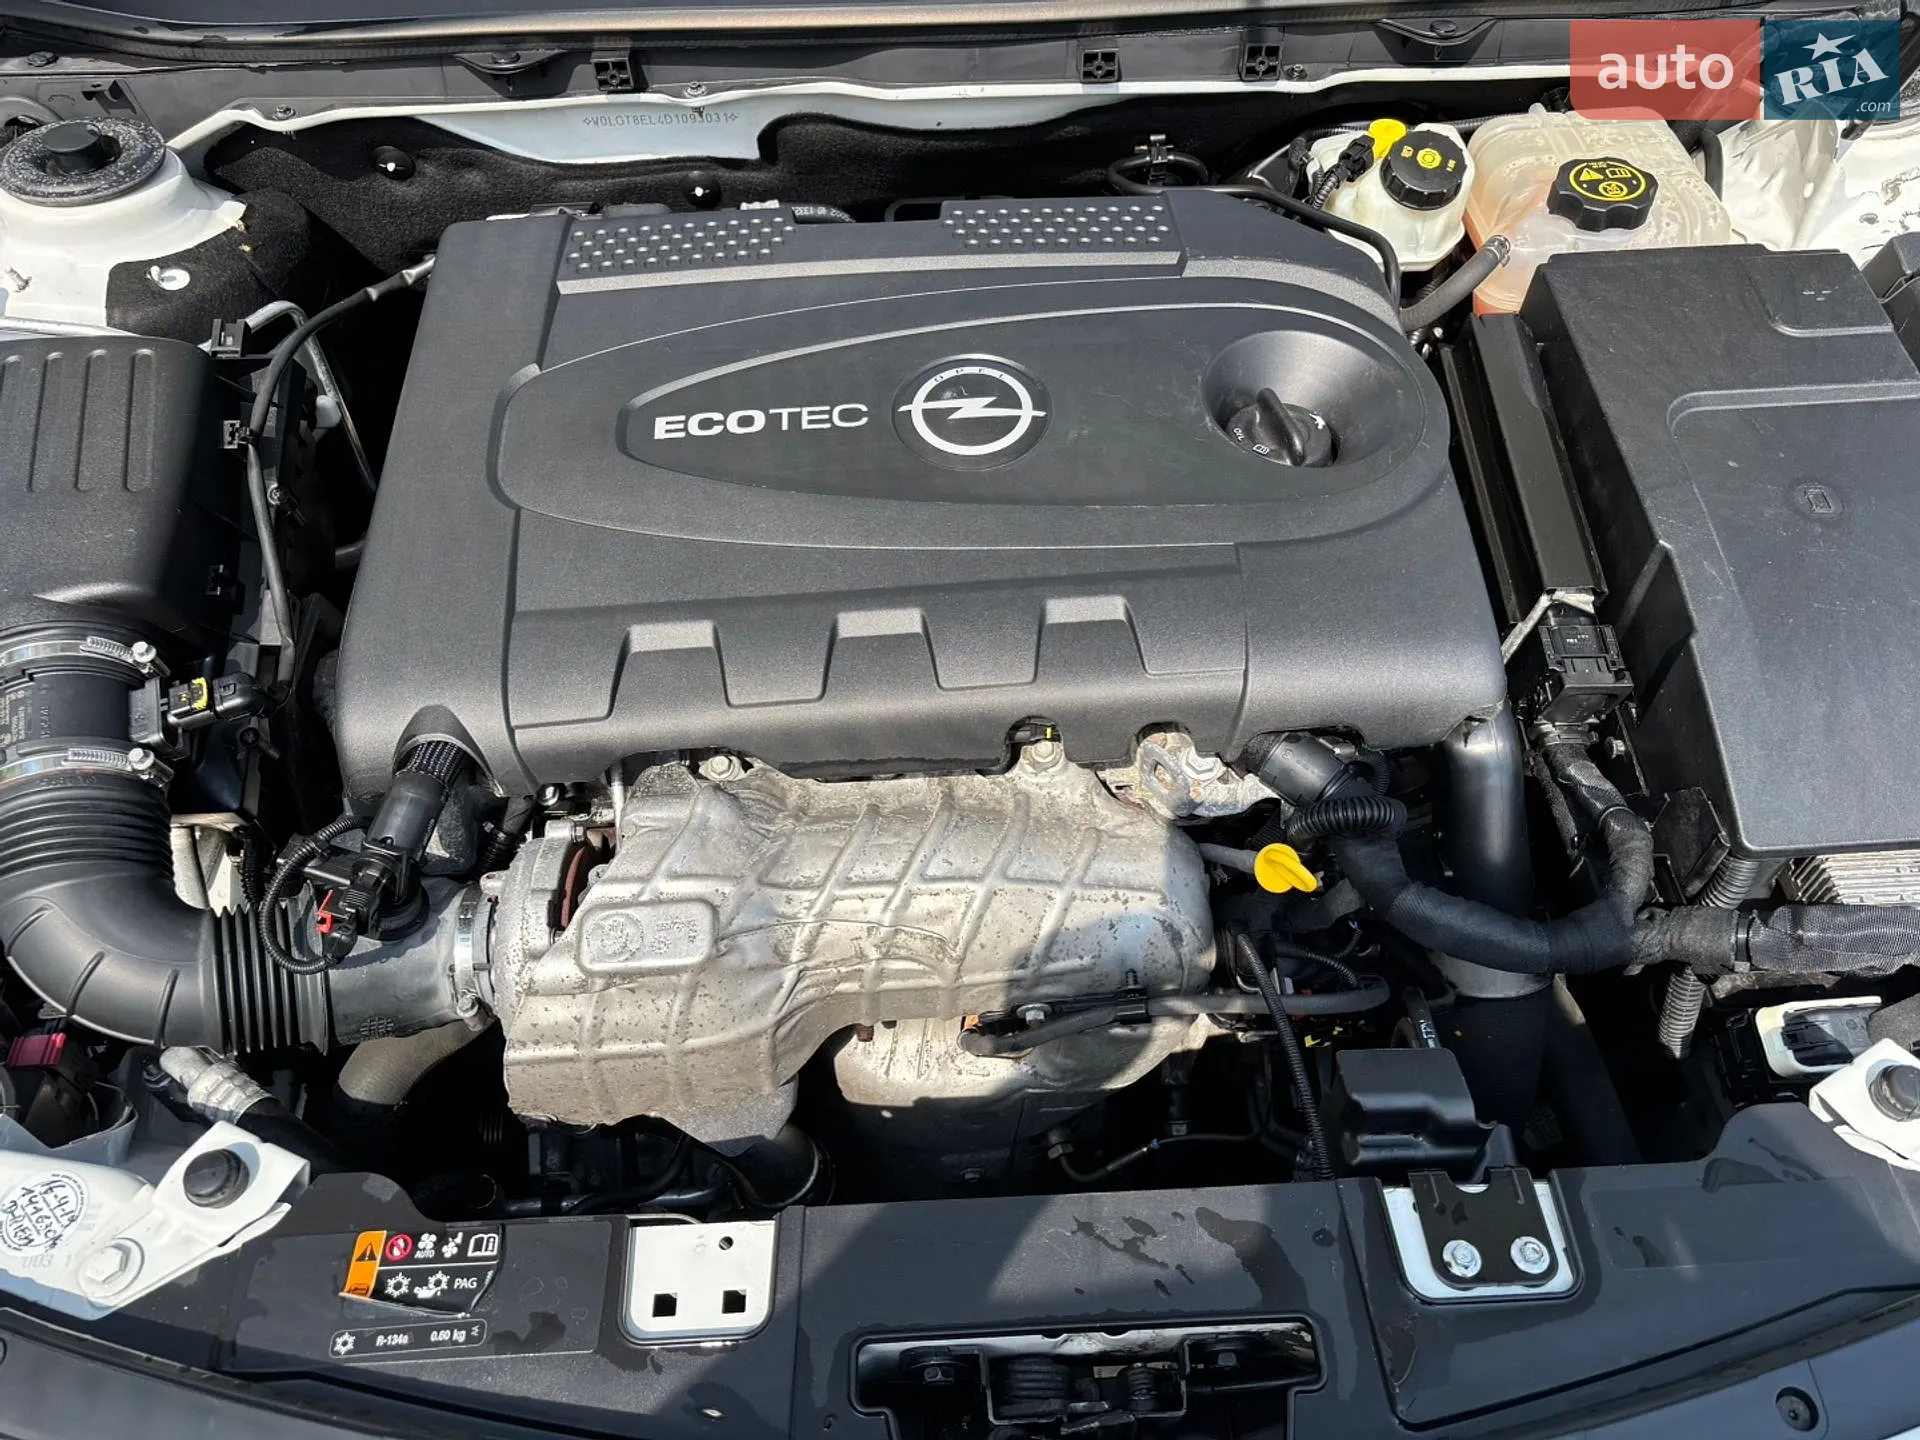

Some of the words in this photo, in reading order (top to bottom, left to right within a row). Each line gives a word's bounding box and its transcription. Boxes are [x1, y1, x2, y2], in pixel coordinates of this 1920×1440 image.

[653, 403, 869, 440] ECOTEC
[414, 1249, 436, 1259] AUTO
[453, 1277, 478, 1289] PAG
[452, 1328, 467, 1343] kg
